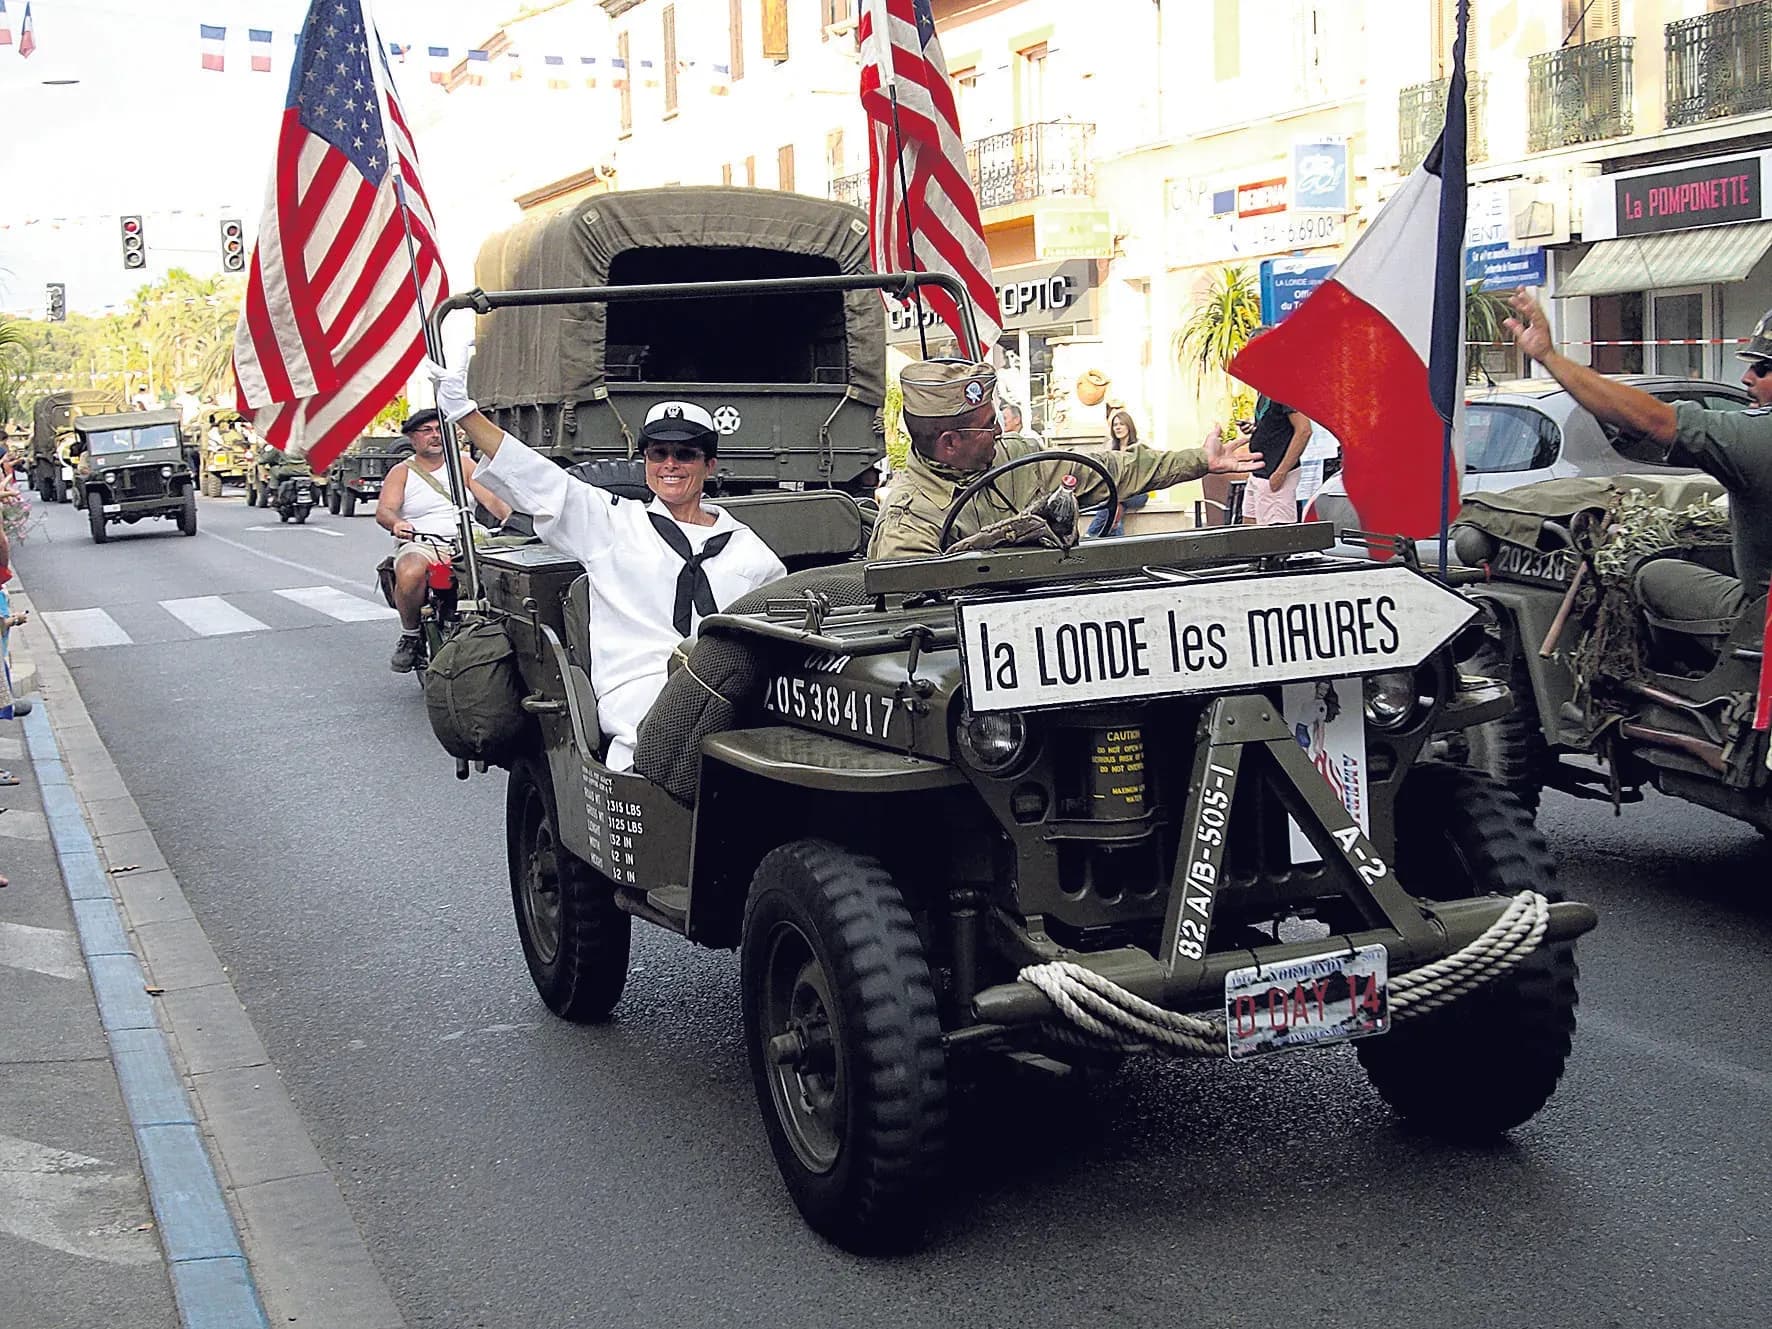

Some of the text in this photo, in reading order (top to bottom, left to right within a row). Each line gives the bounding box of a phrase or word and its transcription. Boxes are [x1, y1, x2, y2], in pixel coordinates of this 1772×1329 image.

[1625, 175, 1749, 220] La POMPONETTE
[1002, 276, 1066, 315] OPTIC
[979, 595, 1399, 692] la LONDE les MAURES
[1107, 730, 1140, 741] CAUTION
[626, 803, 641, 817] LBS
[627, 820, 643, 834] LBS
[1332, 825, 1388, 886] A-2
[1178, 919, 1207, 960] 82
[1236, 971, 1380, 1039] D DAY 14
